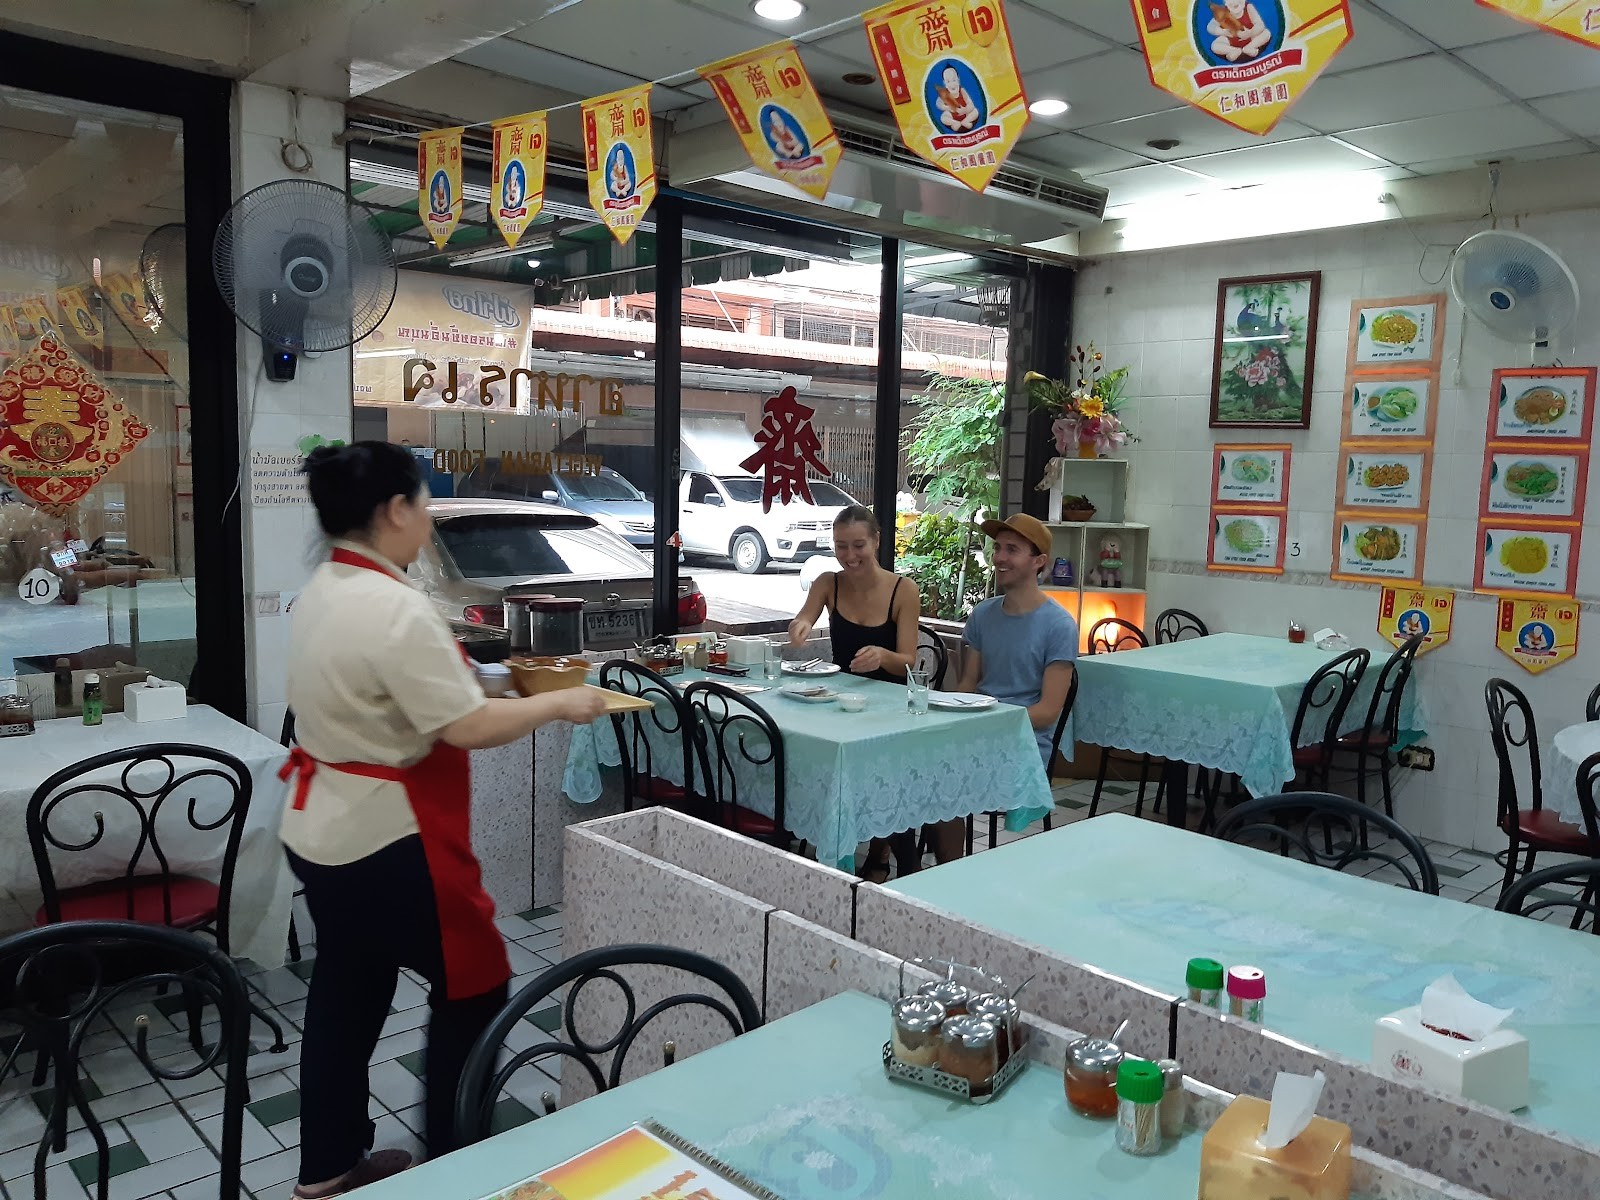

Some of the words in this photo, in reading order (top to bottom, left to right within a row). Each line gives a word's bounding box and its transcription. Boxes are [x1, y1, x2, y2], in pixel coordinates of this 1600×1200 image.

[1211, 55, 1282, 79] ตราเด็กสมบูรณ์
[1290, 542, 1301, 557] 3
[24, 578, 50, 599] 10
[608, 614, 634, 628] 5236
